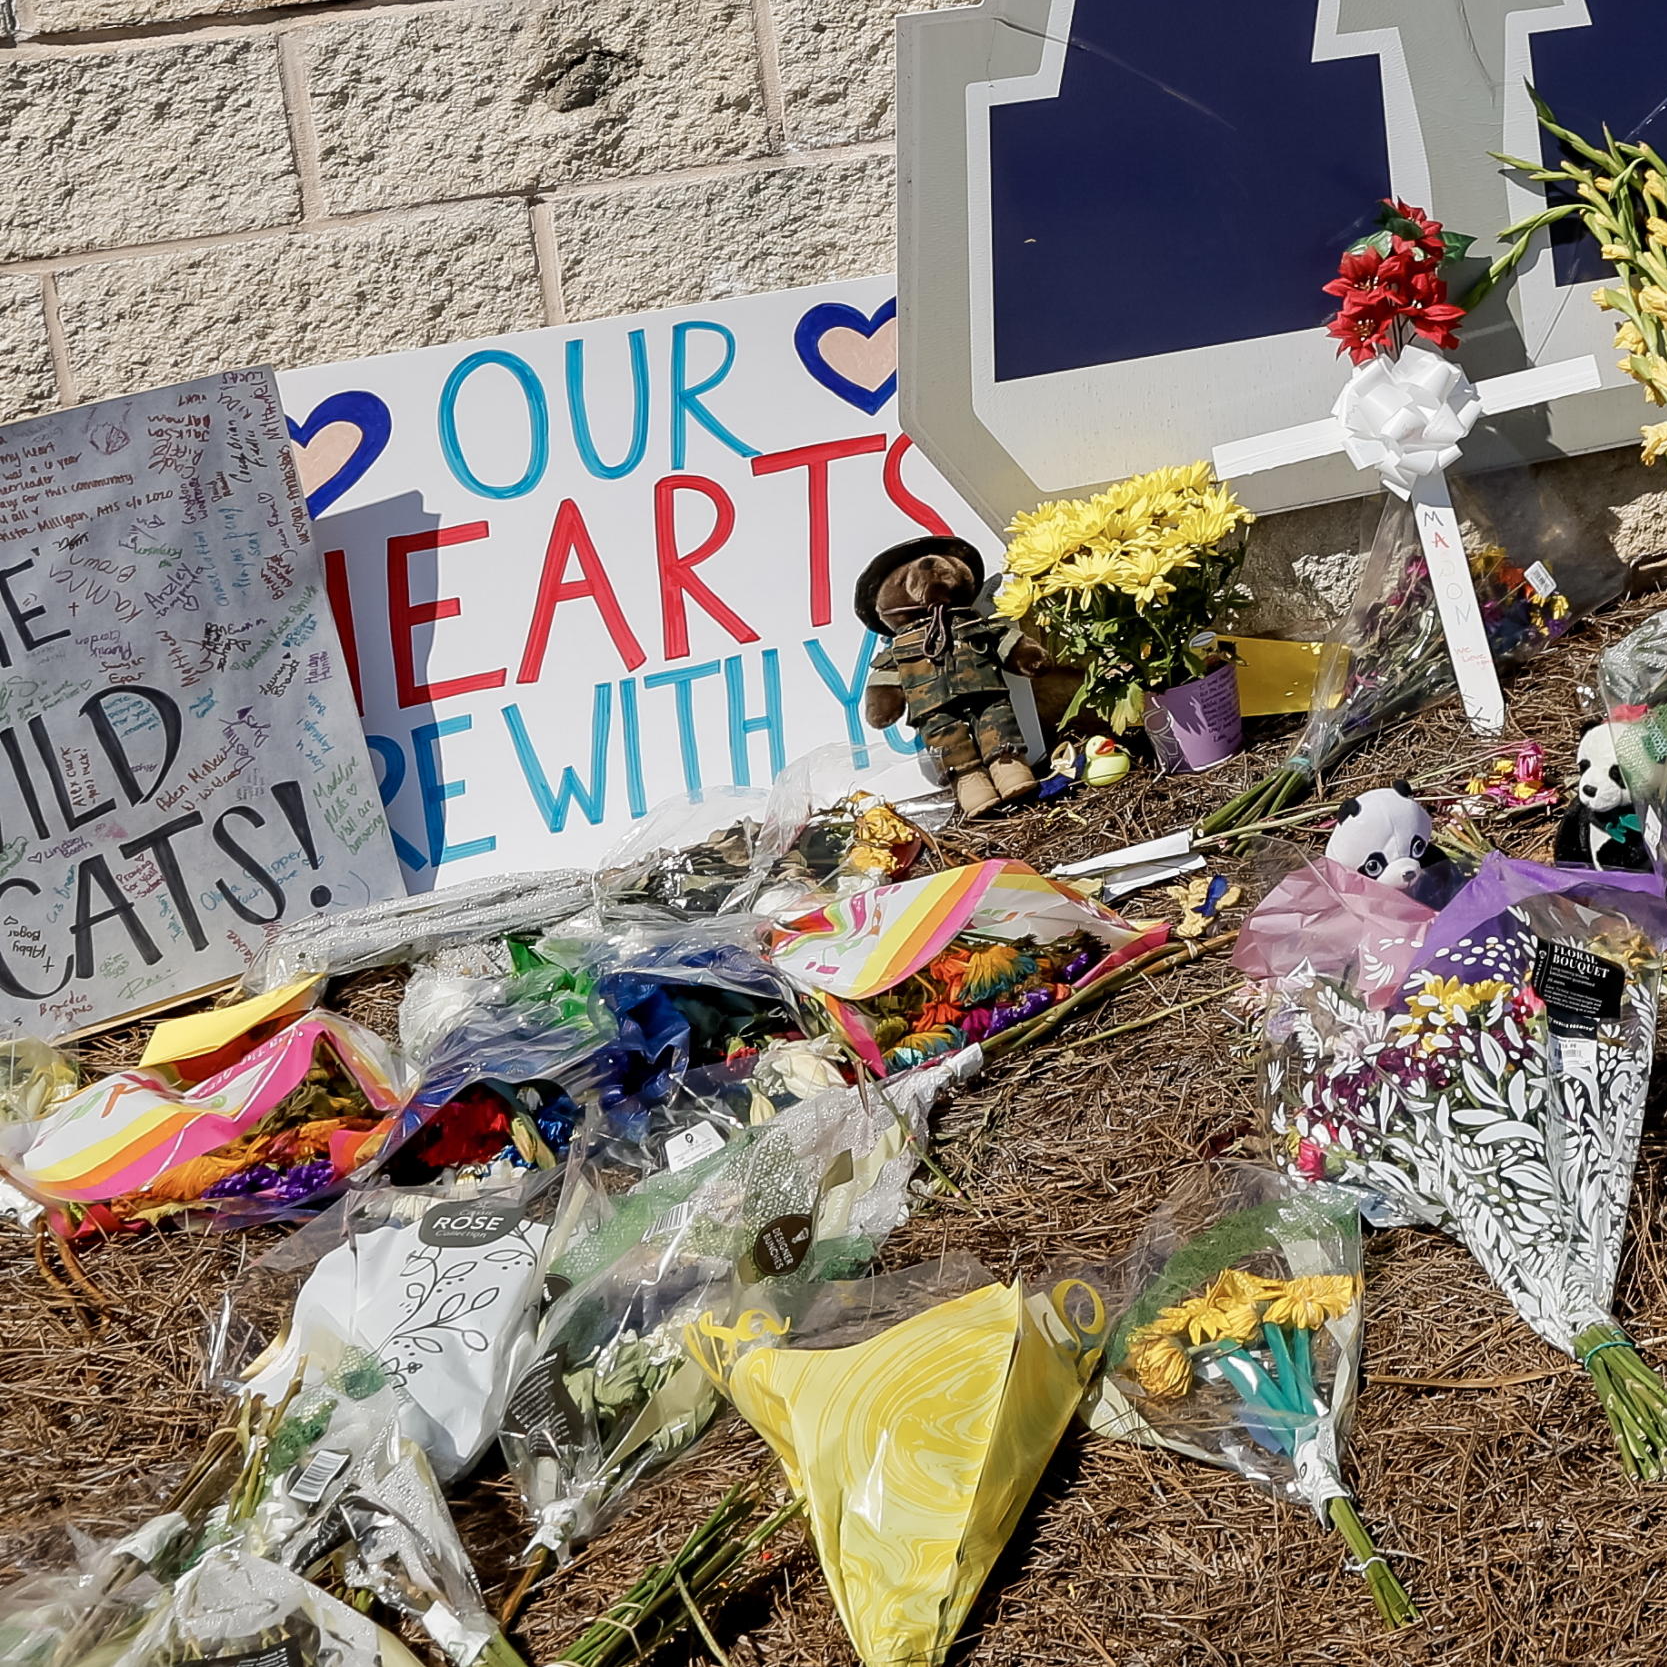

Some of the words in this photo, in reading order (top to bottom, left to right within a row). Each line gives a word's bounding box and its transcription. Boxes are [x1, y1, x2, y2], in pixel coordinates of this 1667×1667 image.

[437, 321, 763, 500] OUR
[1424, 511, 1471, 625] MAON
[0, 686, 182, 854] ILD
[366, 713, 497, 873] RE
[501, 648, 785, 834] WITH
[0, 780, 332, 1001] CATS!
[273, 869, 299, 887] ove
[1552, 954, 1610, 978] BOUQUET
[1554, 945, 1598, 965] FLORAL
[432, 1215, 505, 1231] ROSE
[763, 1234, 785, 1270] BUNCHES
[772, 1227, 795, 1266] DESIGNER
